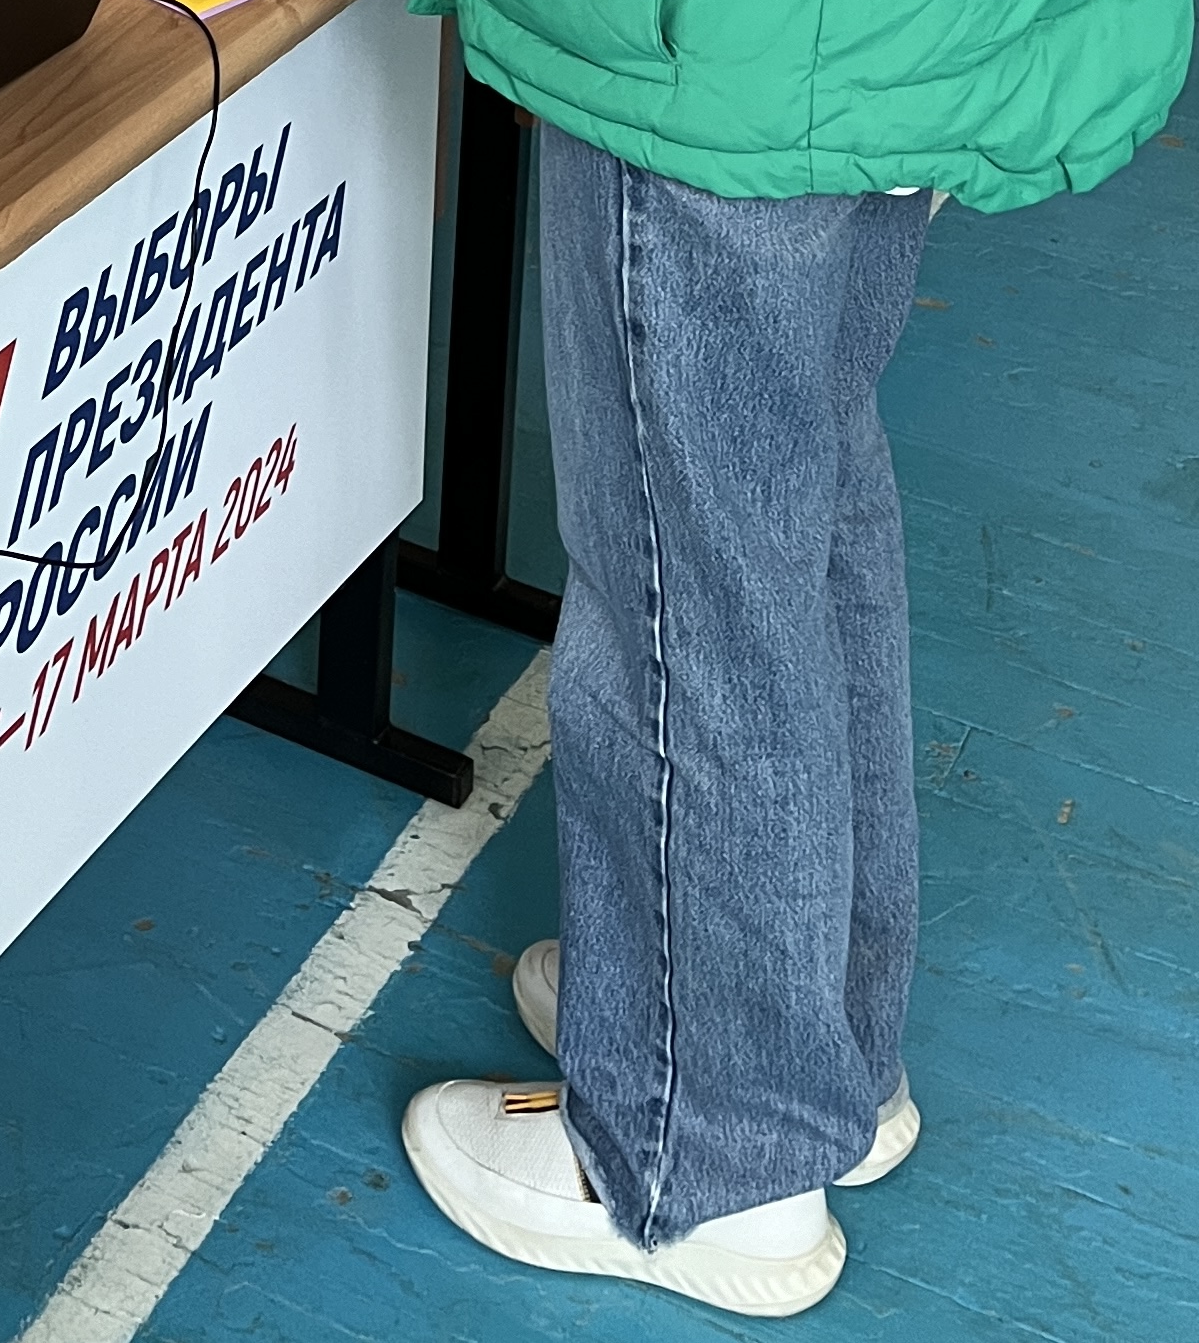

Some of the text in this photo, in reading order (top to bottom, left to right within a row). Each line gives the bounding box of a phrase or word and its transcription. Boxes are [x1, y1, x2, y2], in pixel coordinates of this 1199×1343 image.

[8, 181, 346, 549] ПРЕЗИДЕНТА
[42, 121, 292, 400] ВЫБОРЫ
[72, 508, 208, 704] МАРТА
[211, 423, 297, 565] 2024
